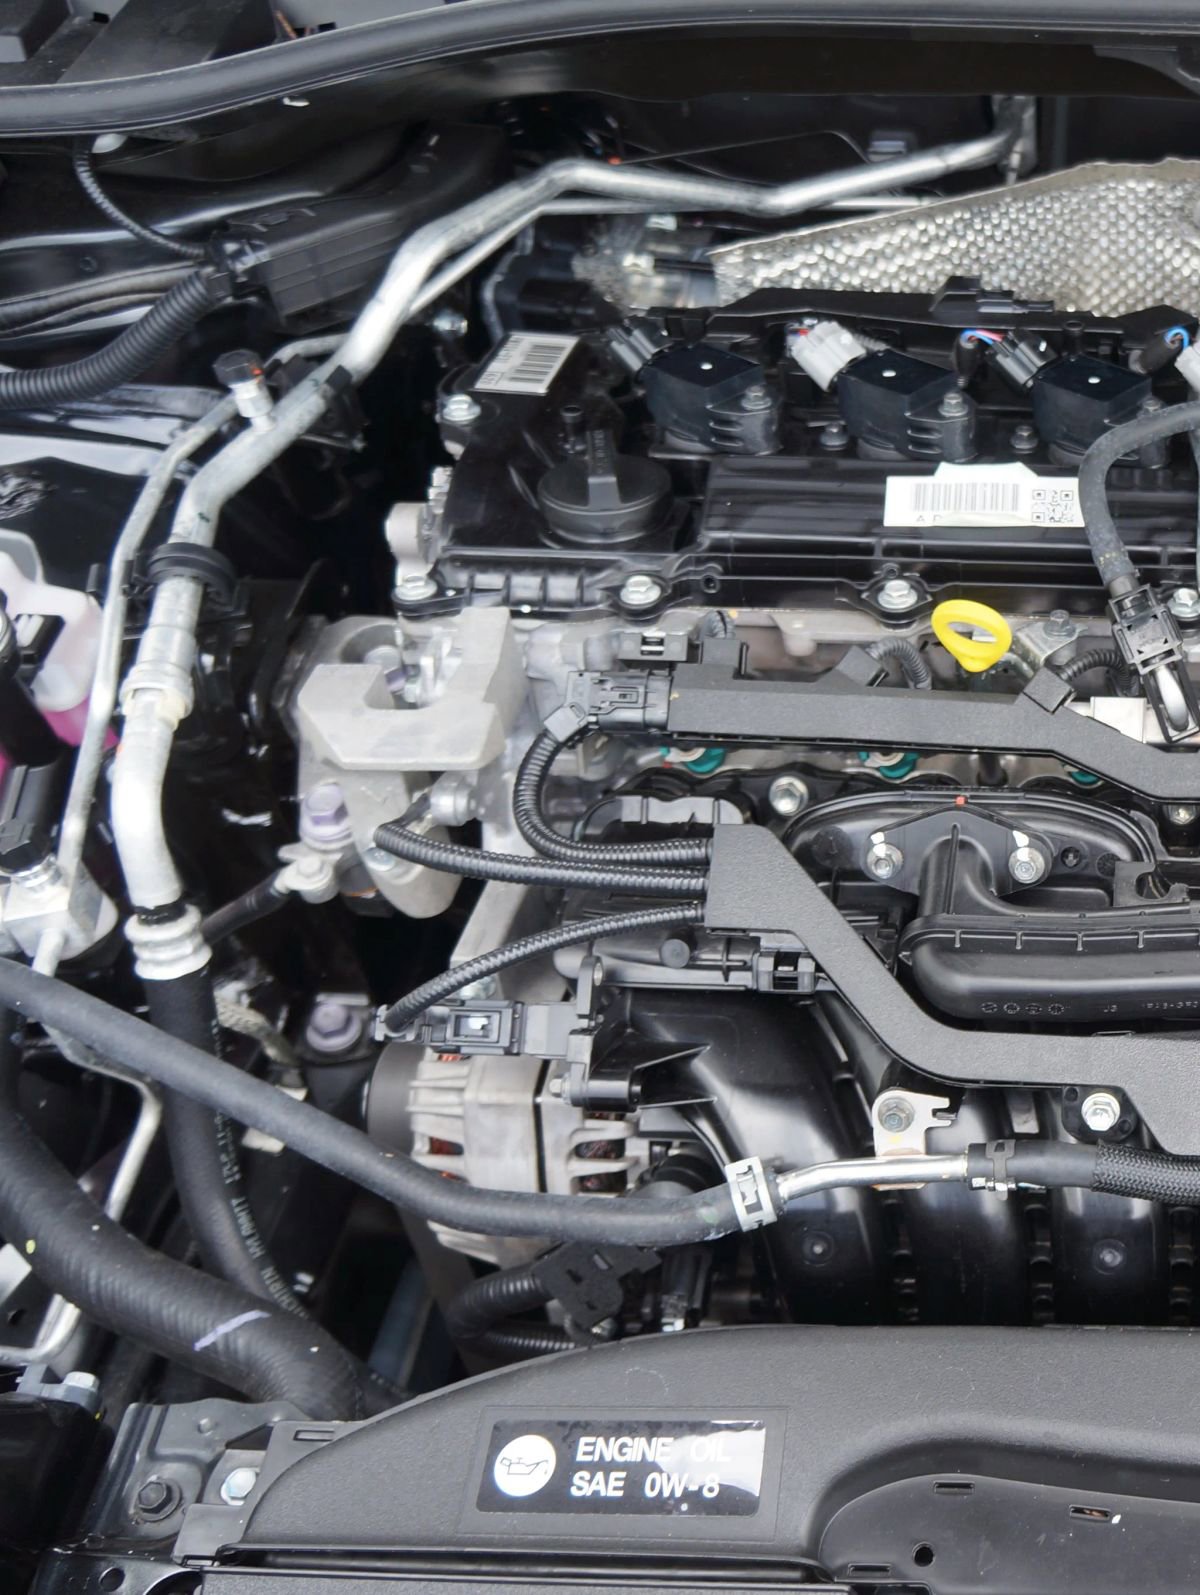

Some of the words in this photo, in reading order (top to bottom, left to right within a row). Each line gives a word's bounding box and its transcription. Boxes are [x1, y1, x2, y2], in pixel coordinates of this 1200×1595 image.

[575, 1436, 673, 1463] ENGINE
[690, 1436, 732, 1462] OIL
[570, 1471, 626, 1497] SAE
[645, 1471, 720, 1498] 0W-8
